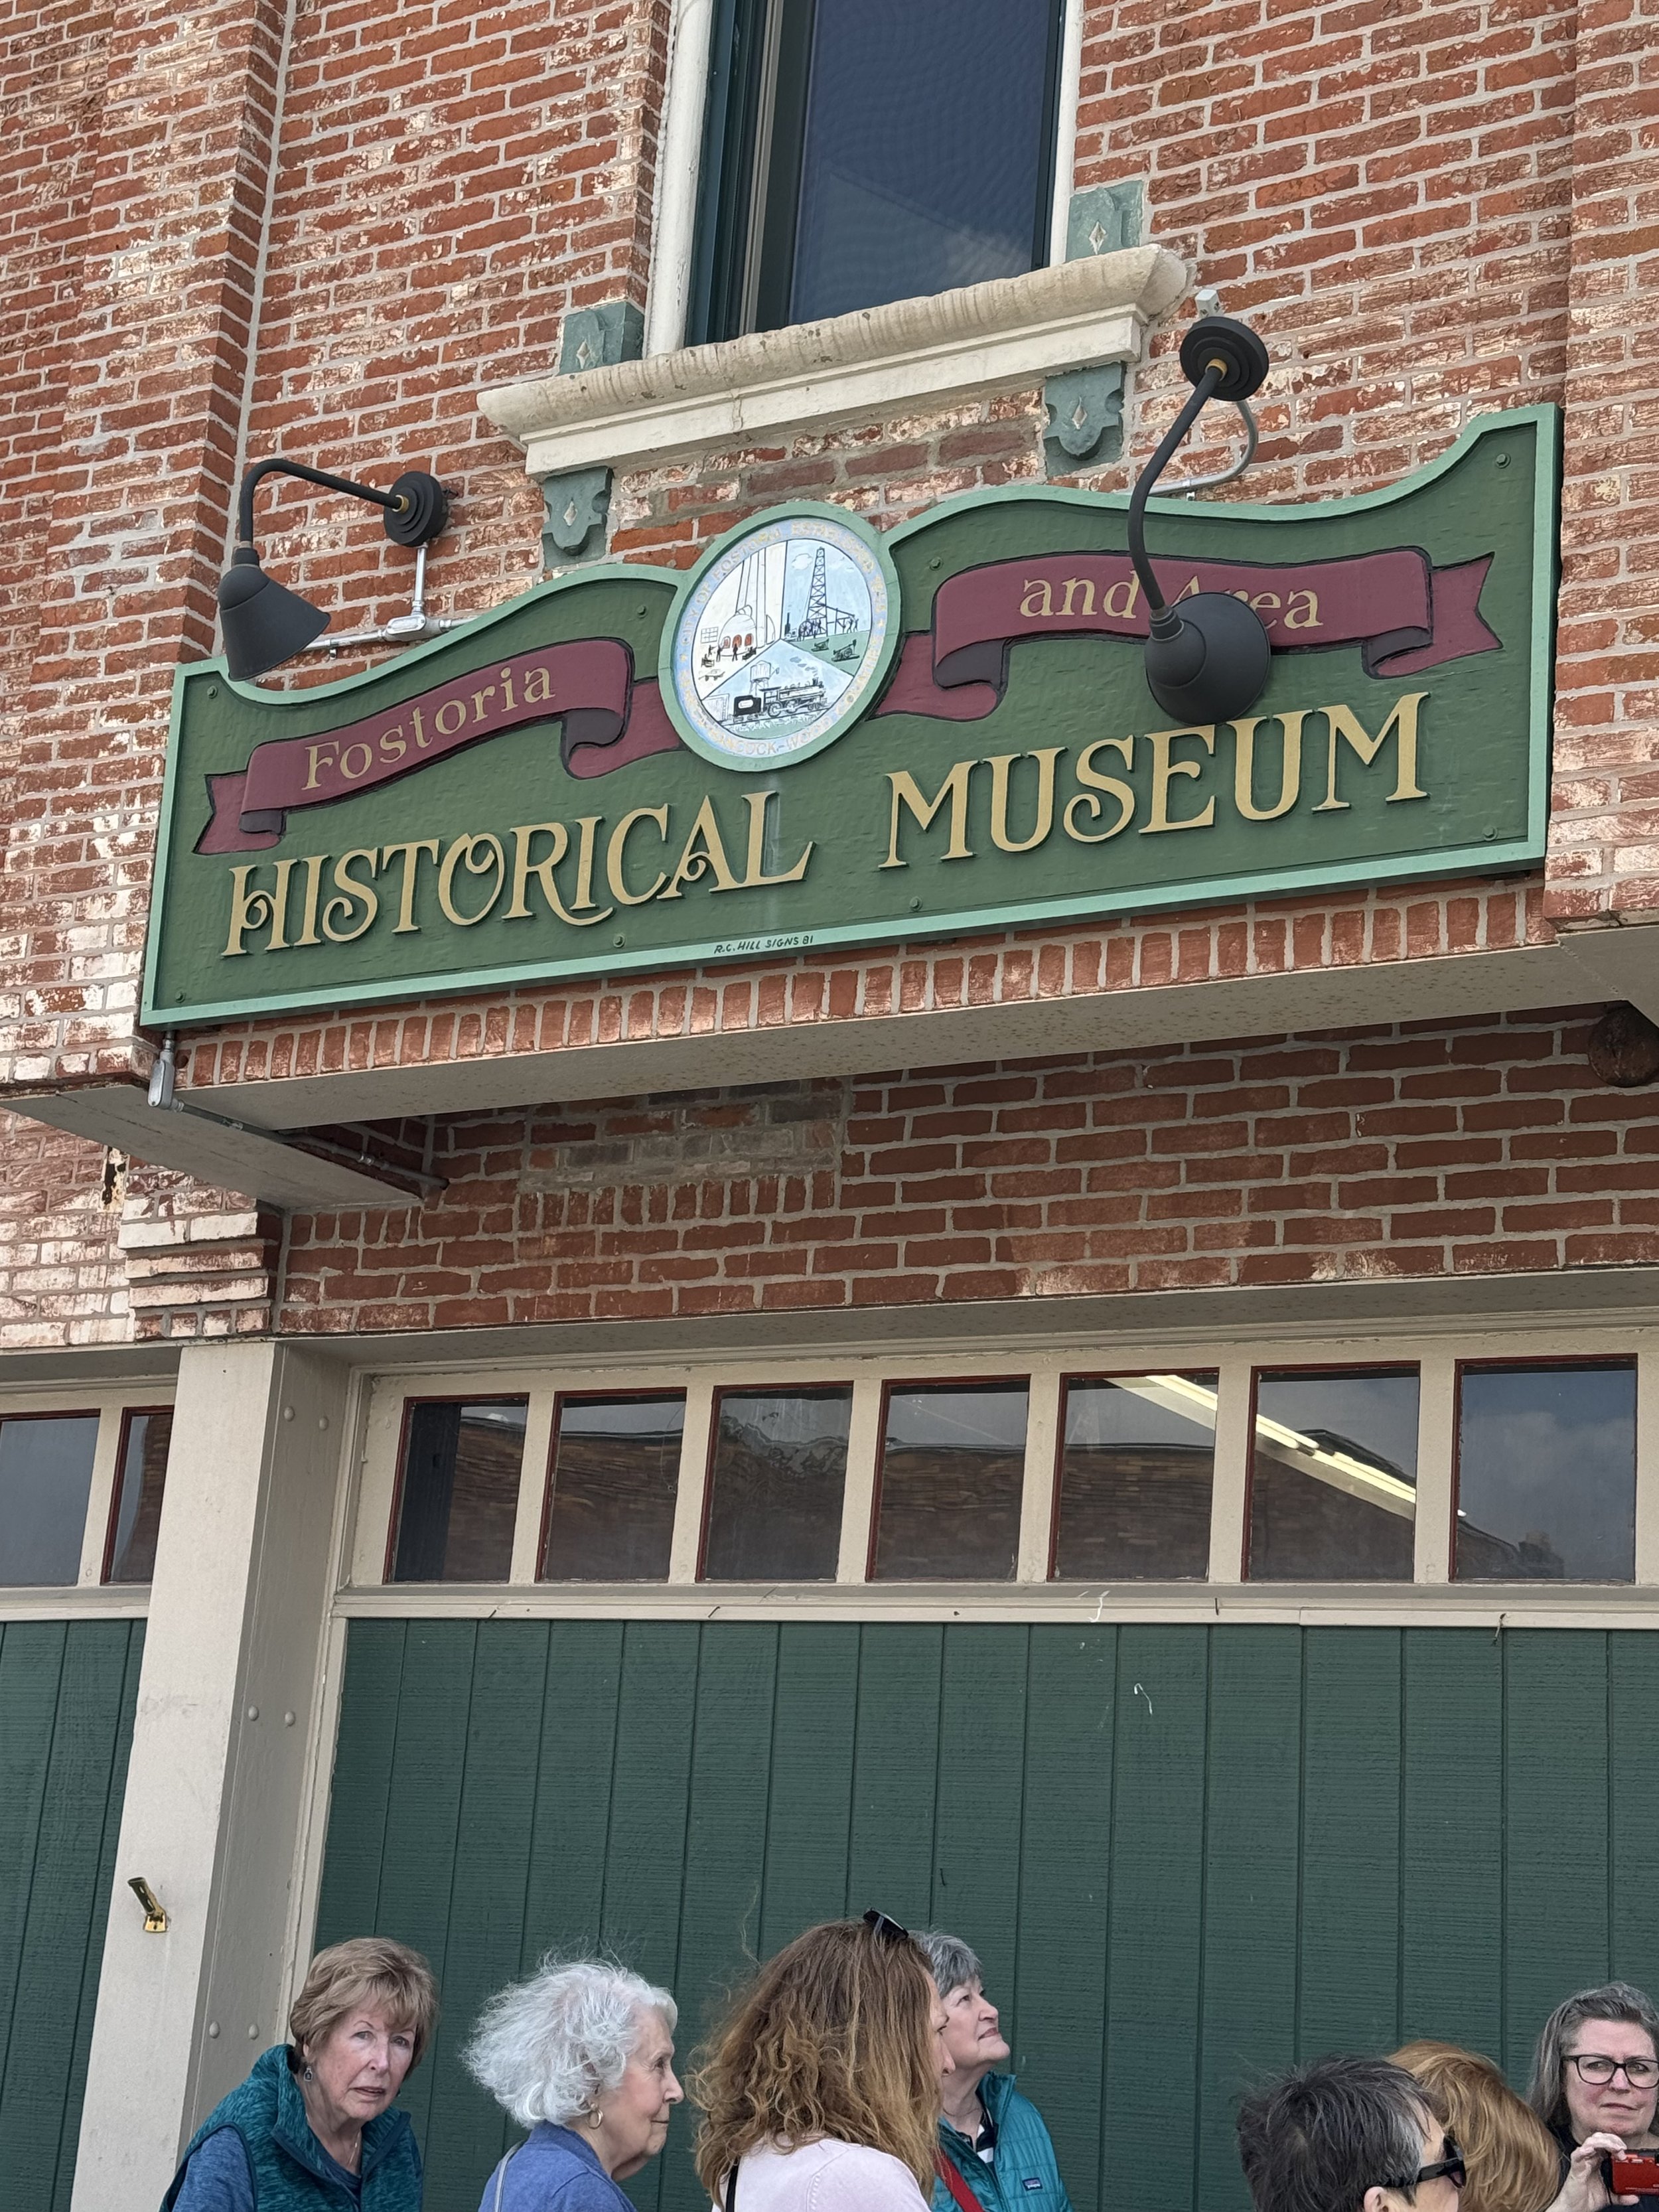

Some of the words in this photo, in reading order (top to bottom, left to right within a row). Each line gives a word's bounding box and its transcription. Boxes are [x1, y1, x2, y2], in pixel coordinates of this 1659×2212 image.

[696, 581, 713, 603] OF
[1019, 569, 1141, 619] and
[1170, 575, 1324, 630] ea
[301, 666, 556, 790] Fostoria
[221, 790, 816, 956] HISTORICAL
[878, 692, 1431, 869] MUSEUM
[737, 940, 761, 950] HILL
[764, 936, 799, 949] SIGNS
